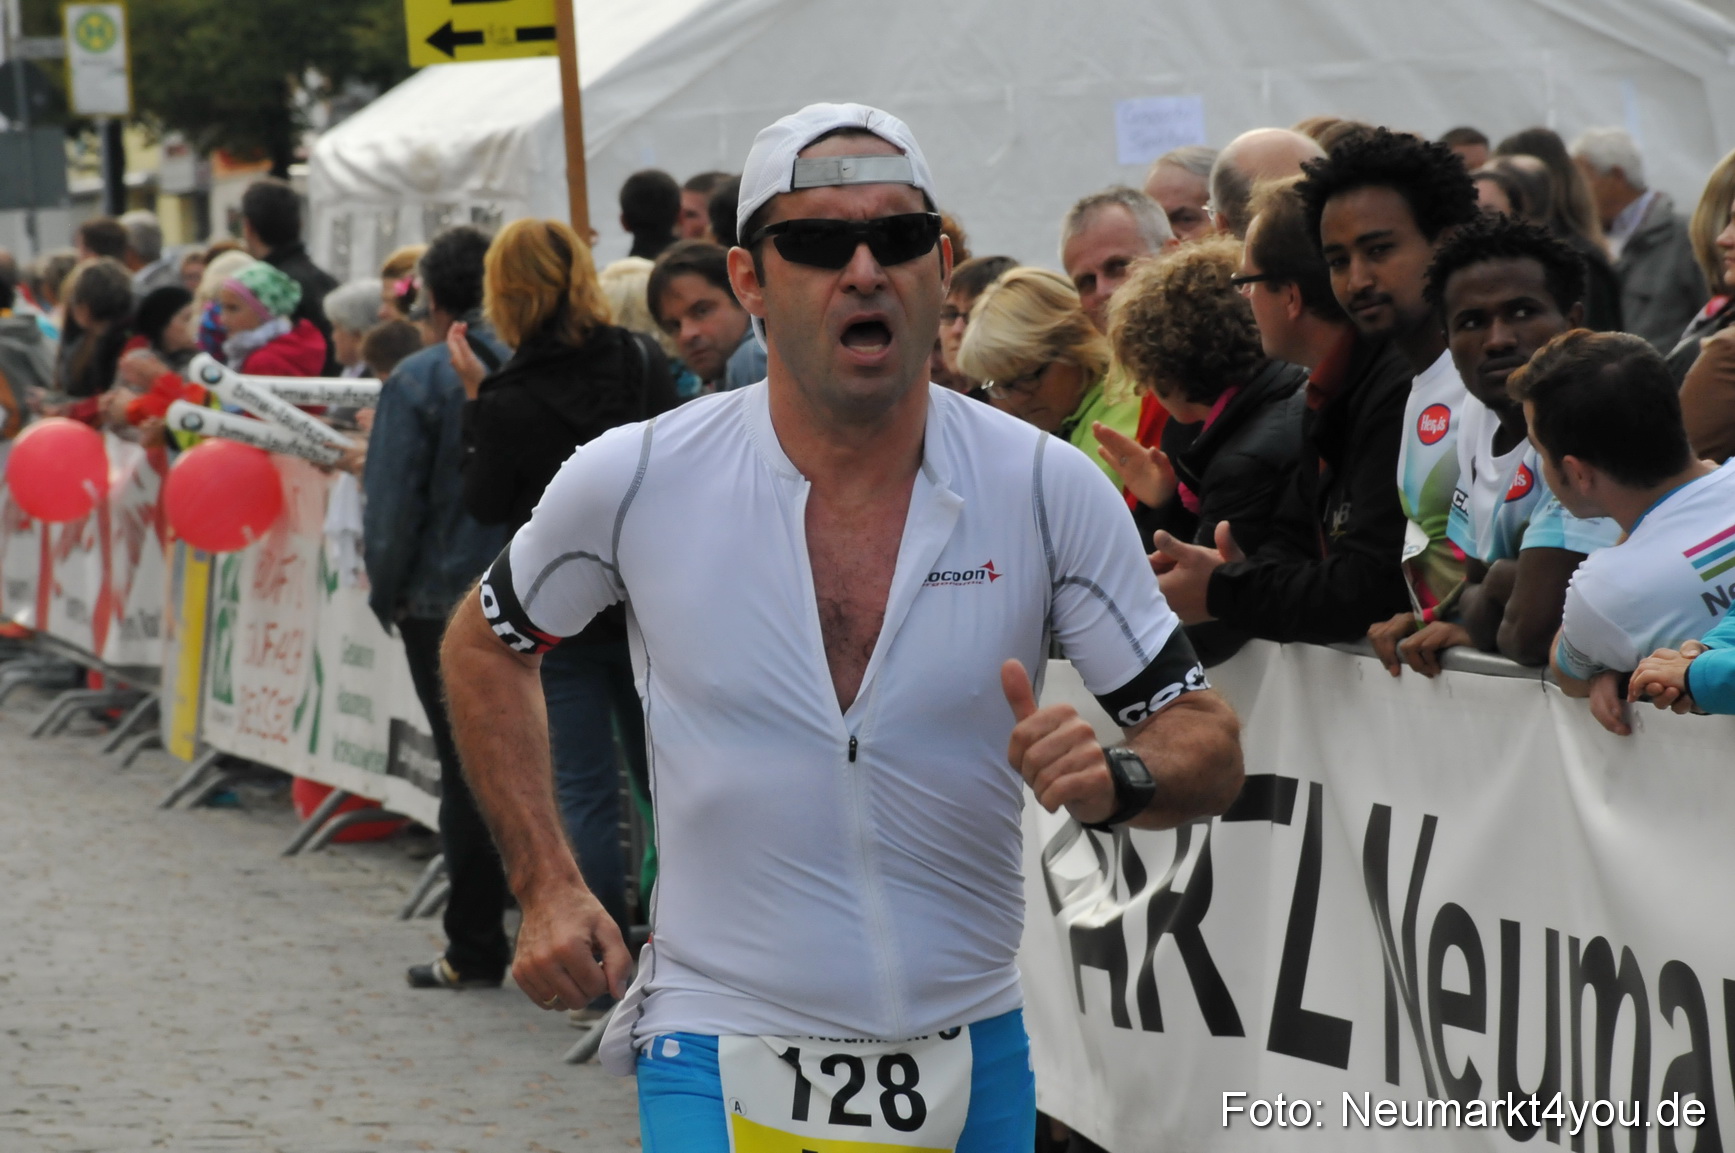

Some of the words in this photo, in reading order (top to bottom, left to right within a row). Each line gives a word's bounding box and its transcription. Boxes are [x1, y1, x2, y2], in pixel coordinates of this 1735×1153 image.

[923, 569, 986, 584] ocoon
[777, 1046, 928, 1133] 128
[733, 1099, 744, 1115] A
